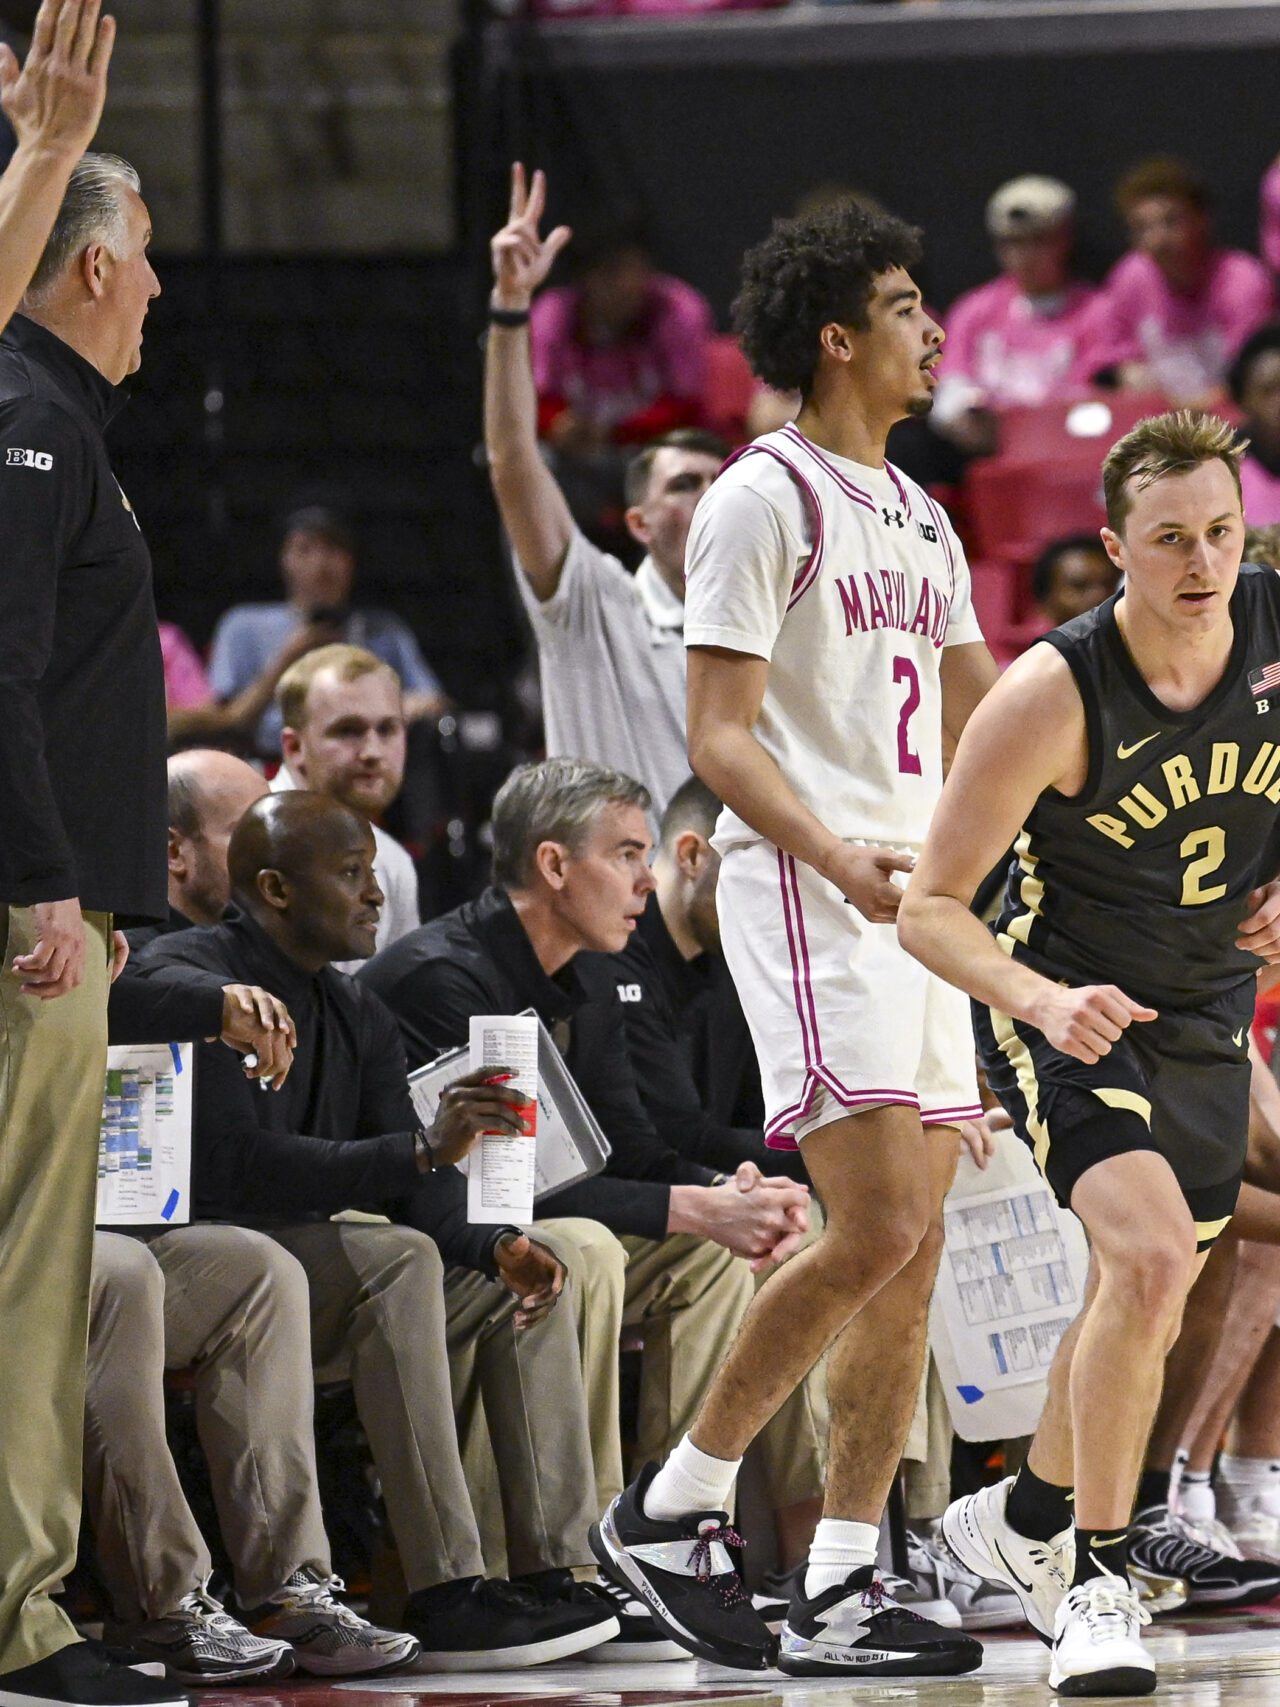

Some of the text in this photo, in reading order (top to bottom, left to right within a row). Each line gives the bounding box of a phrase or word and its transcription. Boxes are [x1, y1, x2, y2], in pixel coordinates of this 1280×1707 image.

[834, 569, 950, 649] MARYLAND
[892, 655, 923, 777] 2
[1179, 825, 1228, 906] 2
[824, 1651, 840, 1661] ALL
[841, 1653, 855, 1662] YOU
